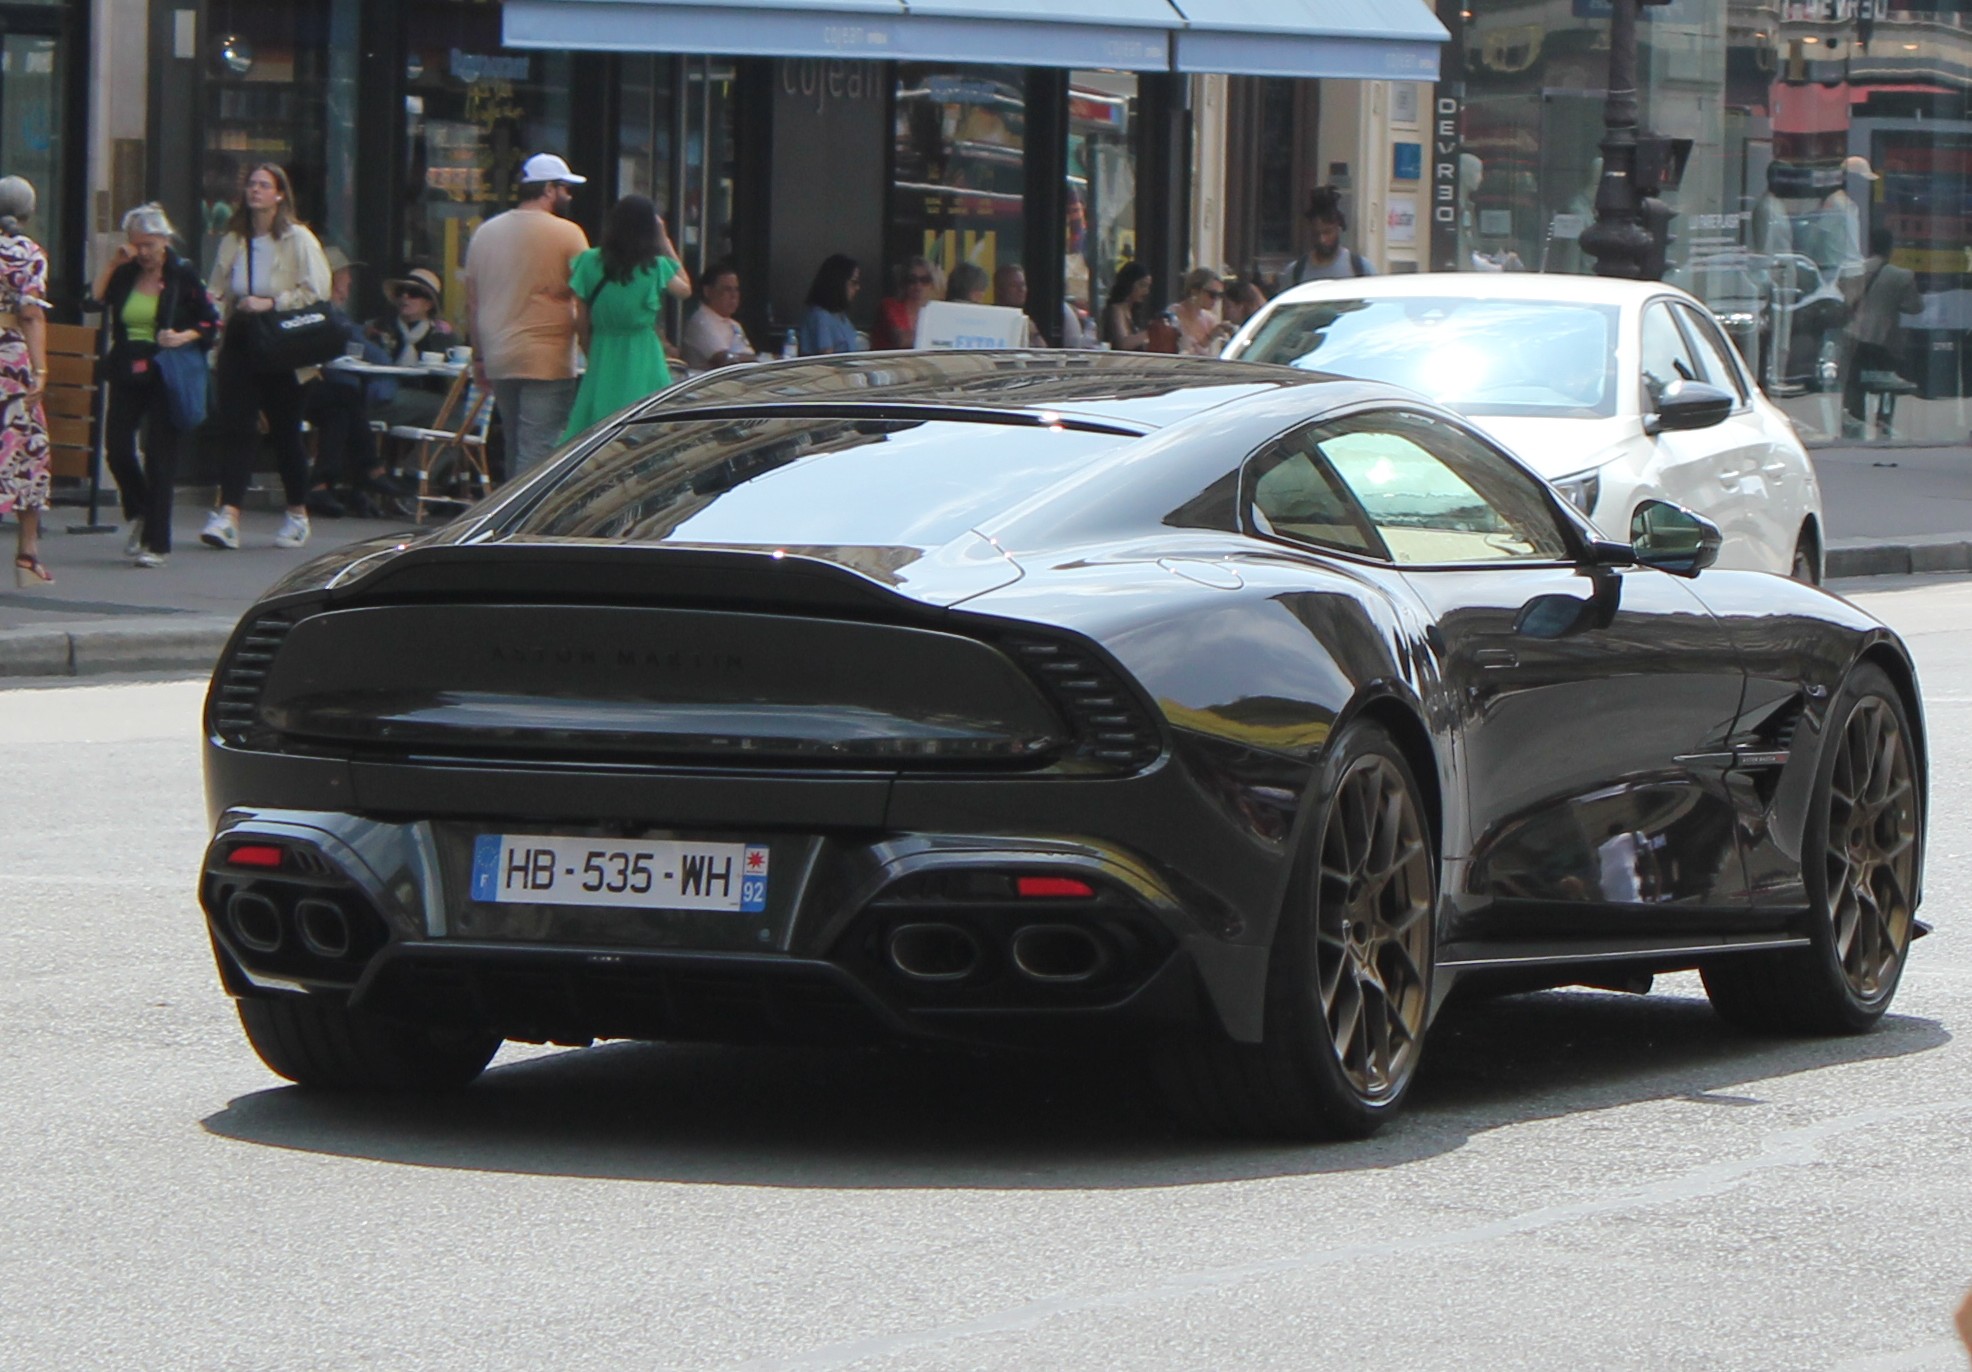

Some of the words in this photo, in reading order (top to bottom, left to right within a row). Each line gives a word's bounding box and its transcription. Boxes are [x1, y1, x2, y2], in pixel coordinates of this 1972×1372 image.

[281, 313, 325, 329] adidas
[479, 875, 488, 887] F
[506, 848, 732, 897] HB-535-WH
[743, 881, 763, 903] 92
